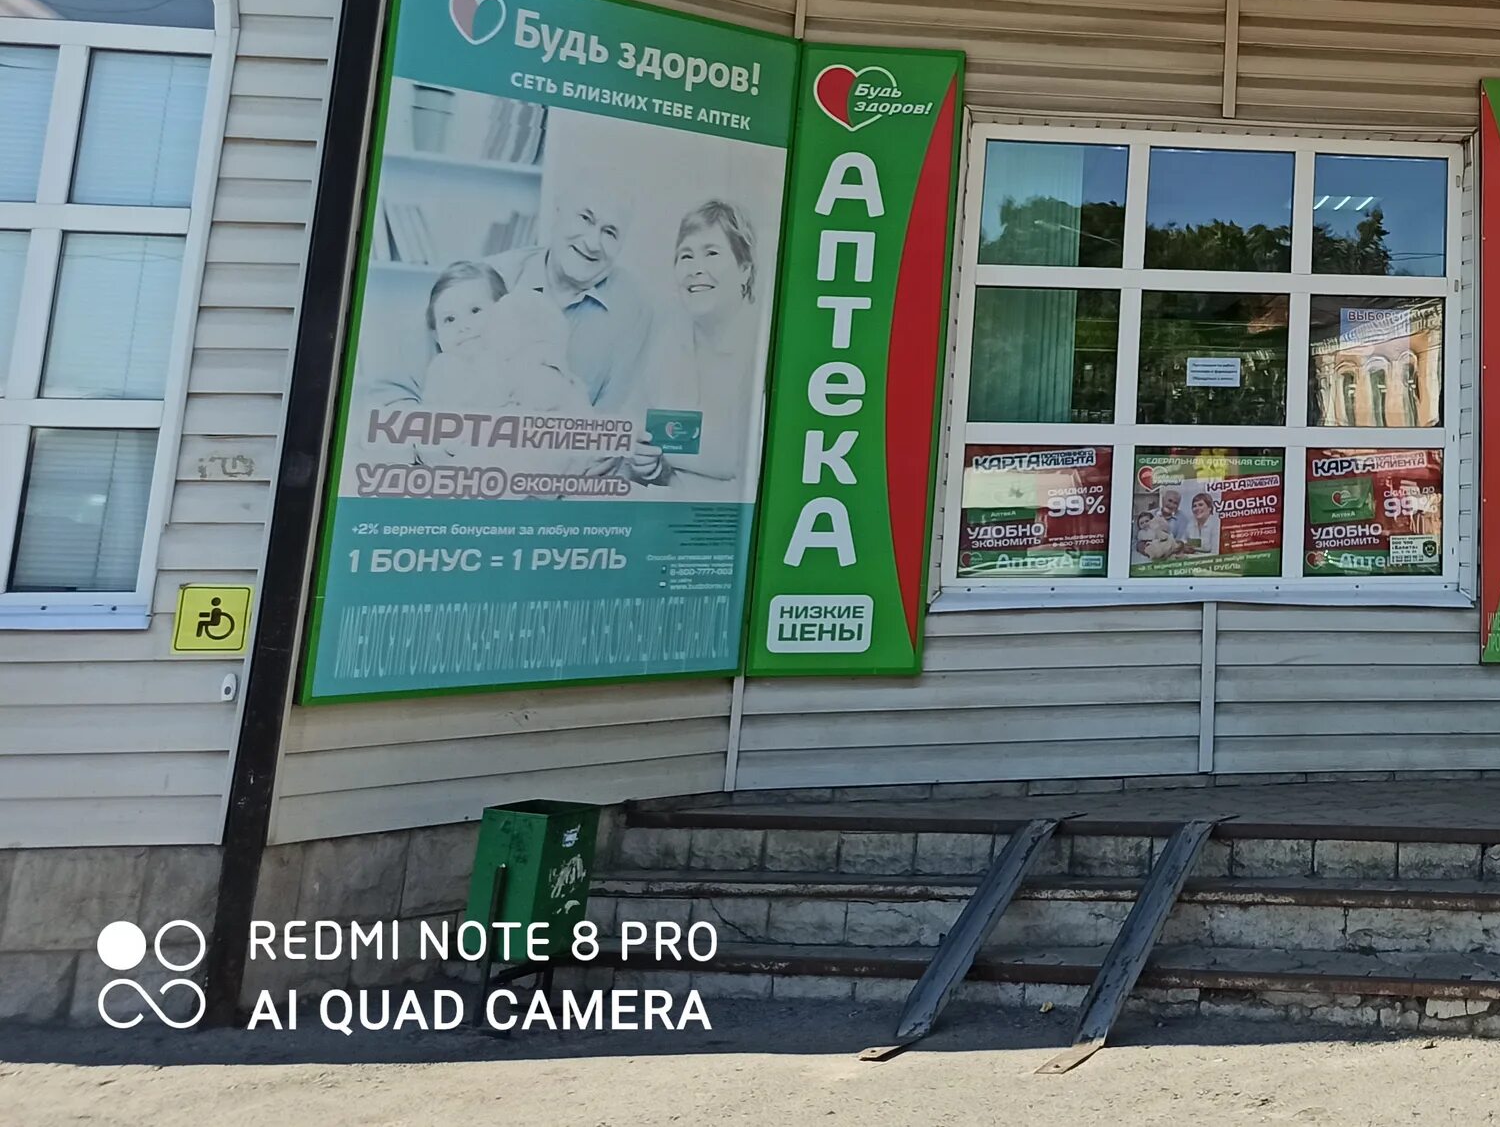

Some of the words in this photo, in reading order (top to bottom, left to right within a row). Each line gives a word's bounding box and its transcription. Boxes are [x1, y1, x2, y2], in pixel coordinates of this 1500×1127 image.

[513, 7, 610, 65] Будь
[617, 41, 761, 96] здоров!
[854, 83, 902, 99] Будь
[510, 71, 559, 94] СЕТЬ
[562, 81, 648, 112] БЛИЗКИХ
[652, 98, 693, 120] ТЕБЕ
[697, 107, 752, 132] АПТЕК
[854, 101, 933, 116] здоров!
[367, 408, 521, 450] КАРТА
[523, 415, 633, 433] ПОСТОЯННОГО
[521, 431, 632, 452] КЛИЕНТА
[974, 454, 1041, 471] КАРТА
[1041, 455, 1094, 467] КЛИЕНТА
[1314, 458, 1376, 475] КАРТА
[1376, 457, 1425, 469] КЛИЕНТА
[358, 464, 505, 498] УДОБНО
[511, 474, 631, 495] ЭКОНОМИТЬ
[1089, 485, 1104, 494] ДО
[1206, 480, 1246, 492] КАРТА
[1422, 485, 1435, 494] ДО
[1047, 495, 1106, 518] 99%
[1214, 495, 1278, 512] УДОБНО
[1219, 507, 1276, 519] ЭКОНОМИТЬ
[351, 523, 379, 535] +2%
[383, 525, 447, 537] вернется
[450, 523, 516, 536] бонусами
[519, 525, 534, 535] за
[537, 524, 580, 538] любую
[582, 525, 632, 538] покупку
[966, 522, 1045, 540] УДОБНО
[1310, 522, 1383, 540] УДОБНО
[971, 536, 1042, 548] ЭКОНОМИТЬ
[1315, 535, 1380, 549] ЭКОНОМИТЬ
[348, 548, 360, 573] 1
[370, 548, 483, 573] БОНУС
[512, 548, 523, 571] 1
[531, 547, 628, 571] РУБЛЬ
[779, 605, 865, 620] НИЗКИЕ
[777, 622, 864, 642] ЦЕНЫ
